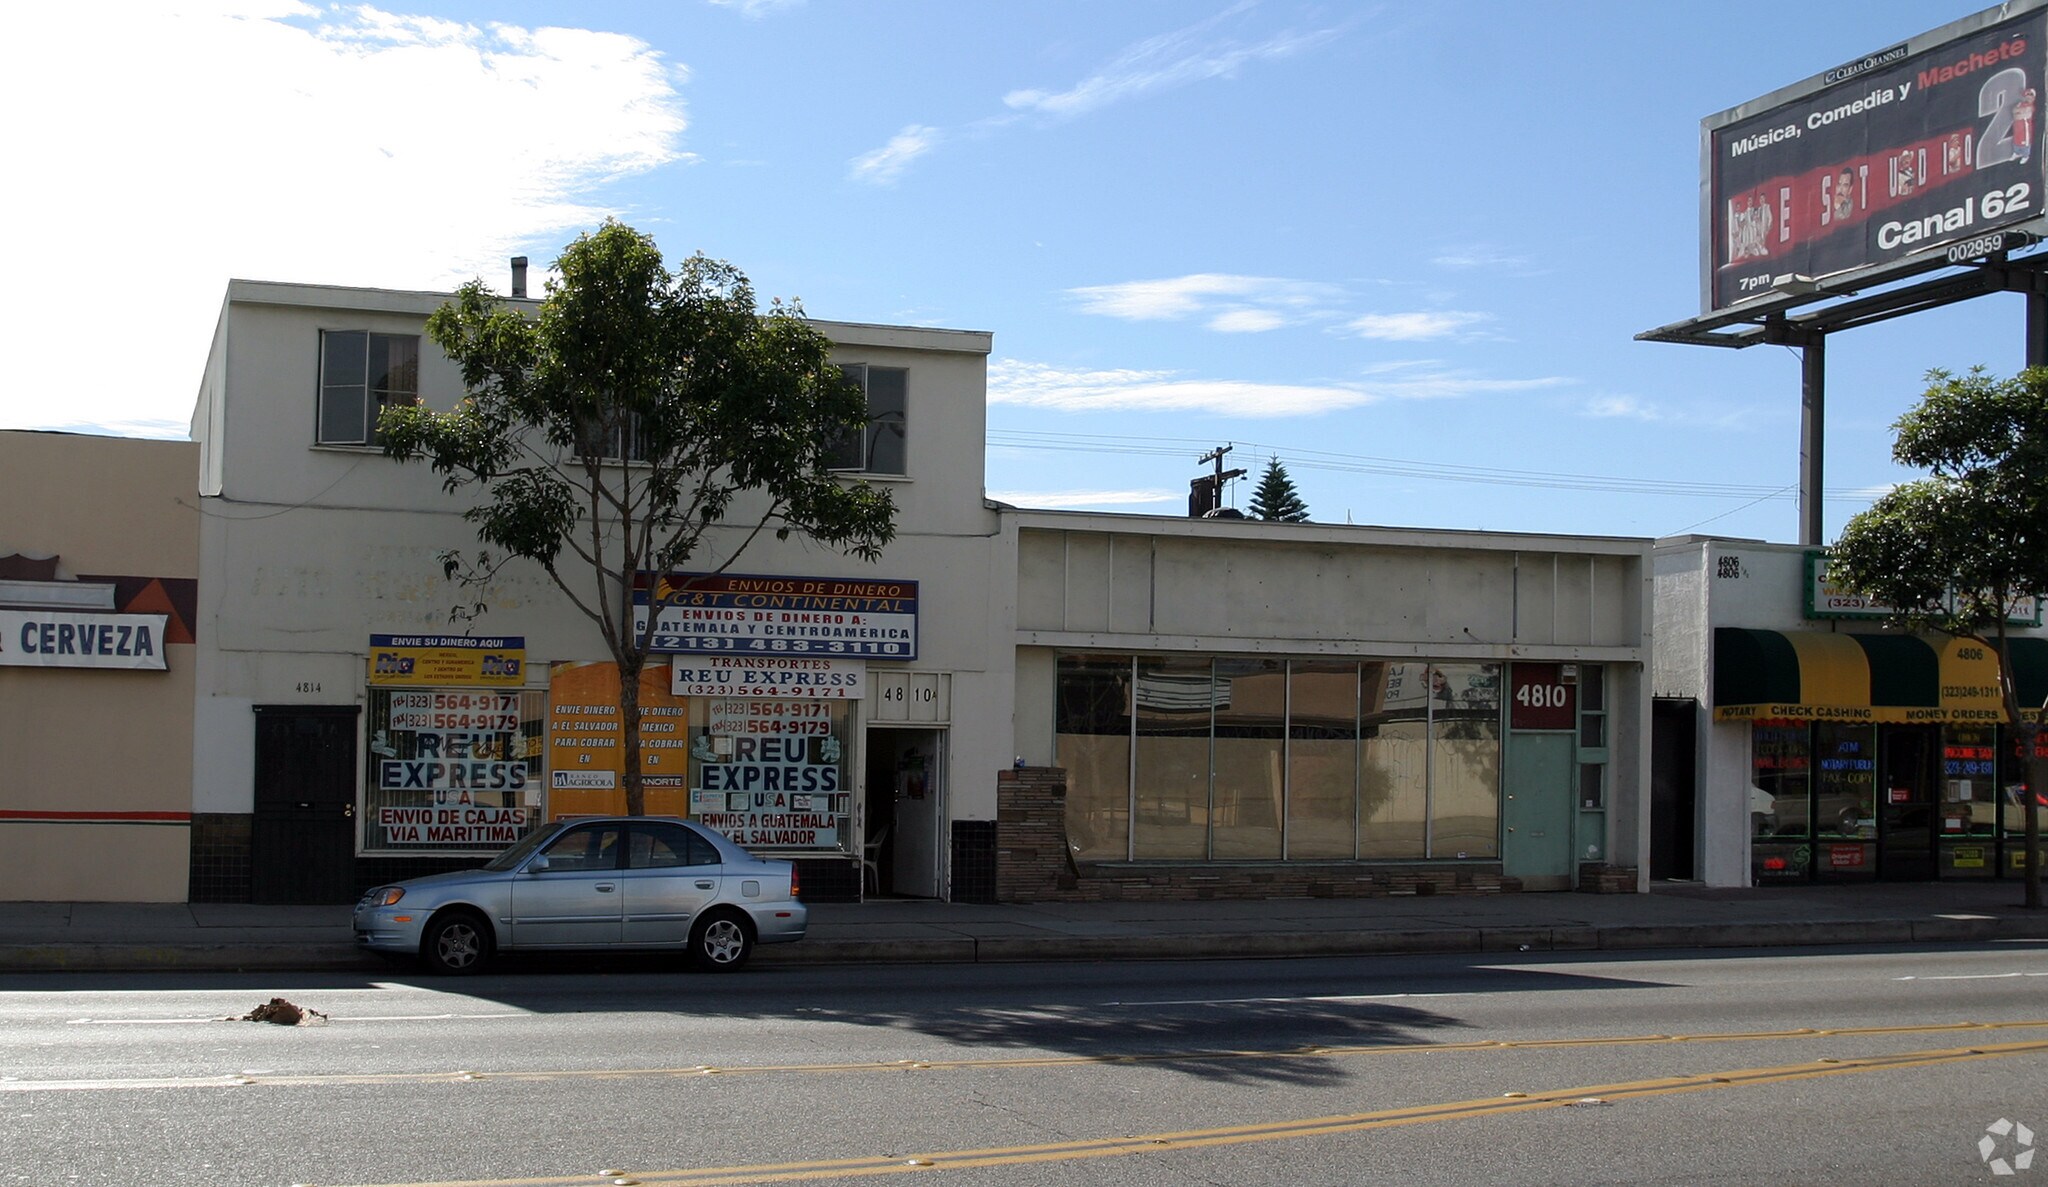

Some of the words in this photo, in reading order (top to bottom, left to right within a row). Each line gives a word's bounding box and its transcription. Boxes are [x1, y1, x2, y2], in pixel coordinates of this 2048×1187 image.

[1731, 126, 1801, 157] Música,
[1807, 88, 1894, 130] Comedia
[1899, 81, 1911, 101] y
[1918, 38, 2027, 90] Machete
[1878, 197, 1974, 250] Canal
[1981, 183, 2030, 219] 62
[1949, 235, 2001, 262] 002959
[1739, 272, 1770, 291] 7pm
[1718, 556, 1739, 567] 4806
[1718, 567, 1739, 578] 4806
[728, 580, 794, 593] ENVIOS
[803, 583, 825, 594] DE
[833, 583, 900, 597] DINERO
[673, 592, 723, 606] G&T
[734, 594, 904, 612] CONTINENTAL
[682, 609, 745, 621] ENVIOS
[754, 611, 773, 622] DE
[782, 612, 844, 625] DINERO
[852, 614, 867, 625] A:
[636, 620, 739, 634] GATEMALA
[748, 624, 758, 634] Y
[764, 624, 910, 640] CENTROAMERICA
[21, 622, 153, 656] CERVEZA
[392, 638, 422, 646] ENVIE
[424, 638, 437, 646] SU
[440, 638, 477, 647] DINERO
[480, 638, 503, 648] AQUI
[750, 638, 900, 654] 483-3110
[1957, 648, 1983, 660] 4806
[375, 653, 415, 674] Ria
[481, 655, 520, 676] Ria
[710, 657, 831, 670] TRANSPORTES
[679, 669, 732, 683] REU
[743, 671, 857, 686] EXPRESS
[296, 682, 321, 693] 4814
[1517, 684, 1567, 707] 4810
[1941, 687, 1999, 698] (323)249-1311
[555, 705, 581, 714] ENVIE
[584, 706, 616, 716] DINERO
[652, 707, 683, 716] DINERO
[1722, 705, 1756, 717] NOTARY
[1771, 706, 1813, 716] CHECK
[1817, 708, 1872, 719] CASHING
[1906, 710, 1947, 720] MONEY
[1952, 710, 1998, 720] ORDERS
[552, 722, 558, 730] A
[561, 722, 570, 730] EL
[574, 722, 618, 731] SALVADOR
[642, 723, 675, 732] MEXICO
[417, 733, 493, 758] REU
[555, 738, 577, 747] PARA
[581, 738, 615, 748] COBRAR
[649, 740, 683, 748] COBRAR
[735, 738, 805, 762] REU
[579, 755, 591, 763] EN
[648, 756, 659, 764] EN
[383, 762, 525, 788] EXPRESS
[703, 766, 836, 791] EXPRESS
[436, 791, 471, 805] USA
[754, 793, 786, 807] USA
[381, 809, 433, 824] ENVIO
[438, 809, 460, 824] DE
[465, 810, 526, 825] CAJAS
[702, 813, 745, 828] ENVIOS
[748, 814, 757, 828] A
[761, 814, 835, 829] GUATEMALA
[390, 826, 420, 841] VIA
[427, 827, 516, 842] MARITIMA
[722, 831, 730, 841] Y
[734, 830, 747, 844] EL
[751, 830, 816, 844] SALVADOR
